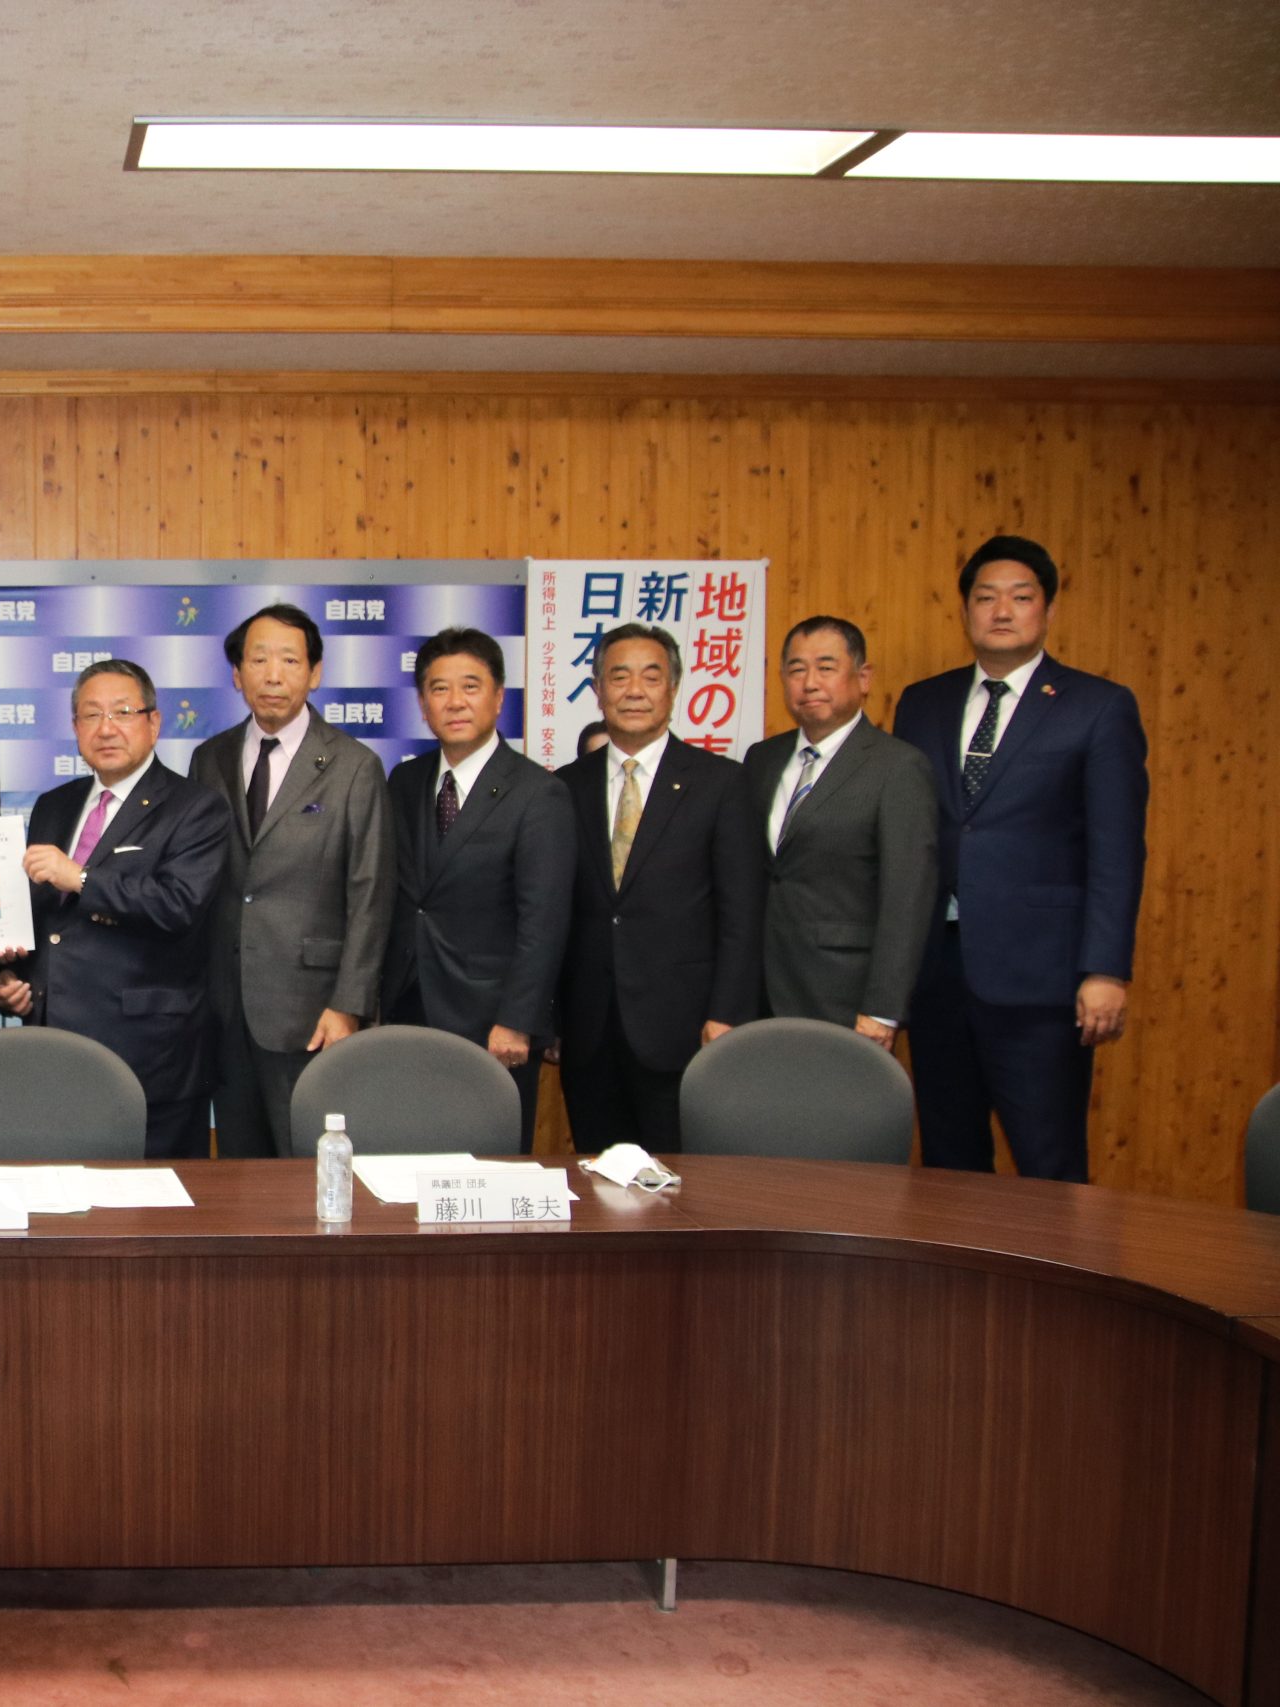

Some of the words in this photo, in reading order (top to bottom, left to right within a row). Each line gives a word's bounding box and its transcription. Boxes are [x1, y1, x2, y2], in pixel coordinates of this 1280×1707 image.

[325, 600, 385, 621] 自民党
[542, 571, 557, 631] 所得向上
[636, 571, 690, 631] 新
[541, 641, 556, 717] 少子化対策
[324, 702, 384, 724] 自民党
[435, 1196, 483, 1222] 藤川
[511, 1195, 561, 1221] 隆夫
